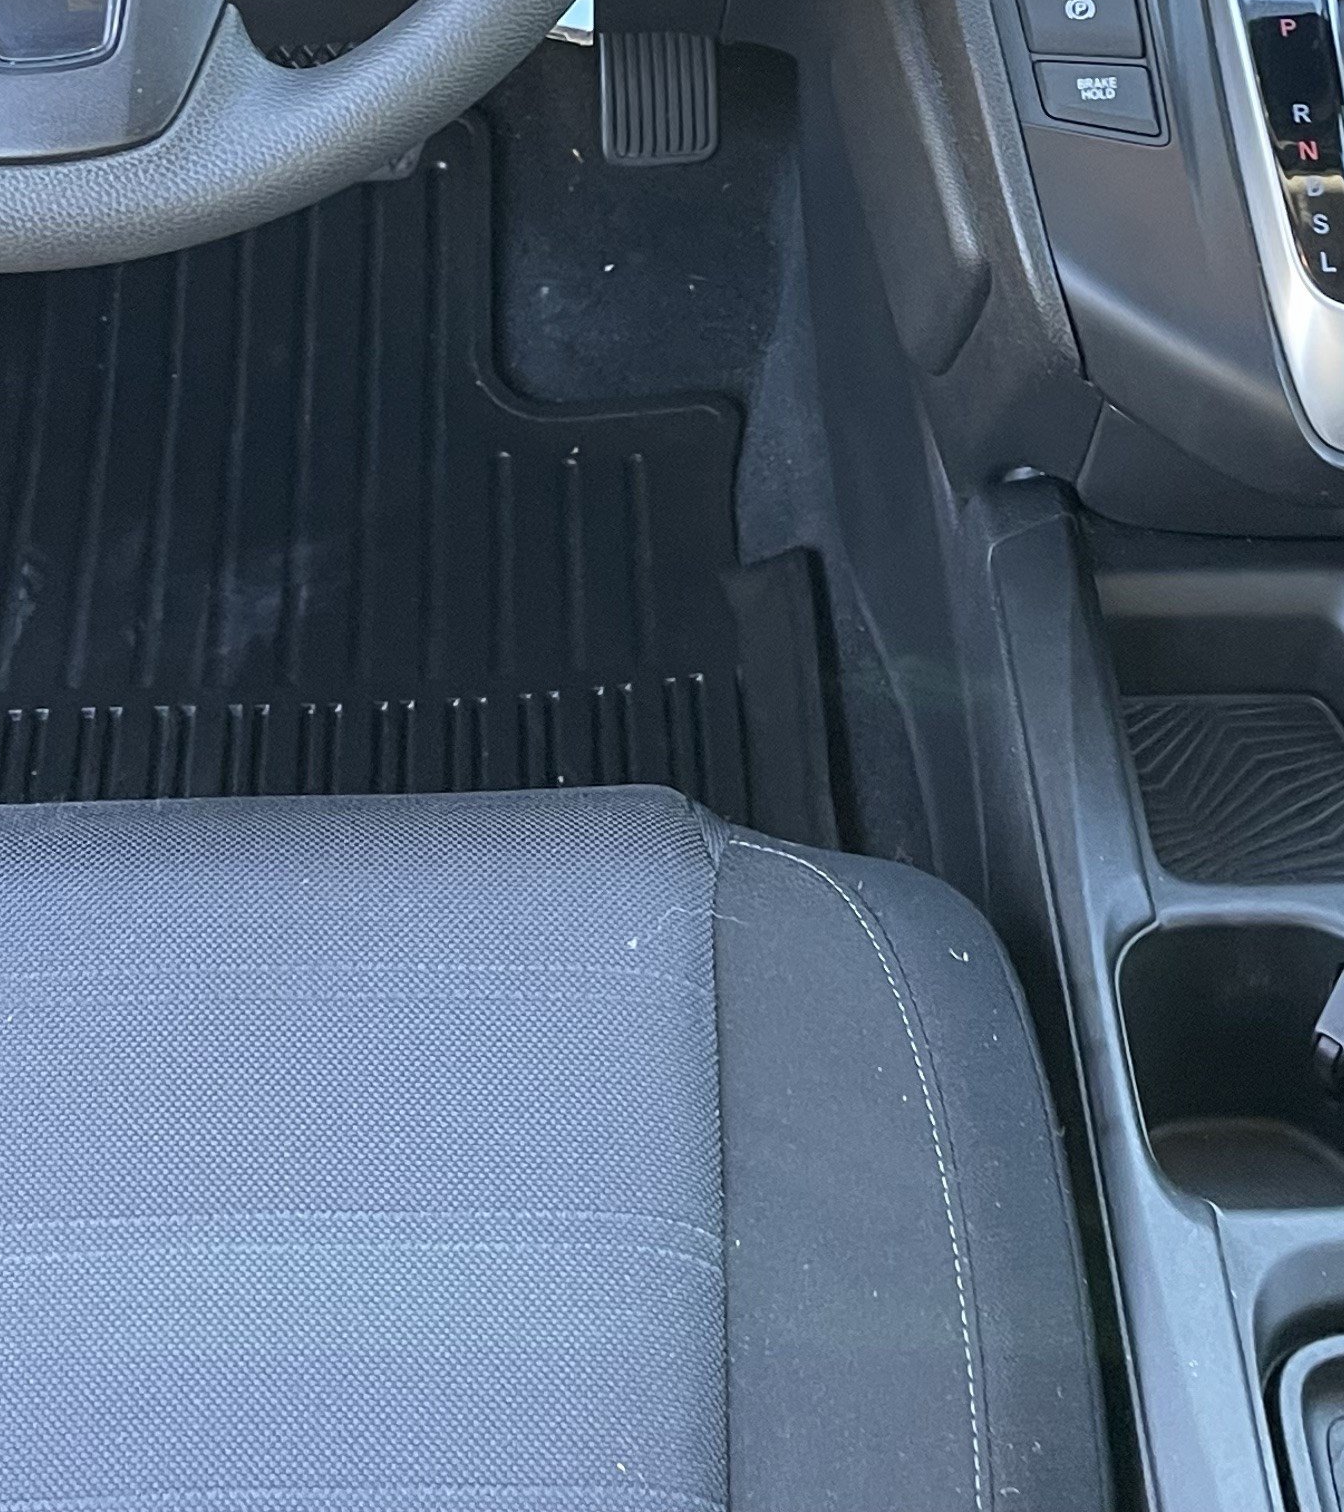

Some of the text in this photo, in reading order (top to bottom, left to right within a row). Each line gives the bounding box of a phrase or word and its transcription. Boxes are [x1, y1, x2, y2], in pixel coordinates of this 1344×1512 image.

[1280, 19, 1296, 37] P
[1077, 77, 1117, 90] BRAKE
[1080, 88, 1116, 100] HOLD
[1292, 104, 1311, 124] R
[1298, 141, 1318, 160] N
[1308, 176, 1324, 197] D
[1312, 214, 1330, 234] S
[1320, 252, 1337, 273] L
